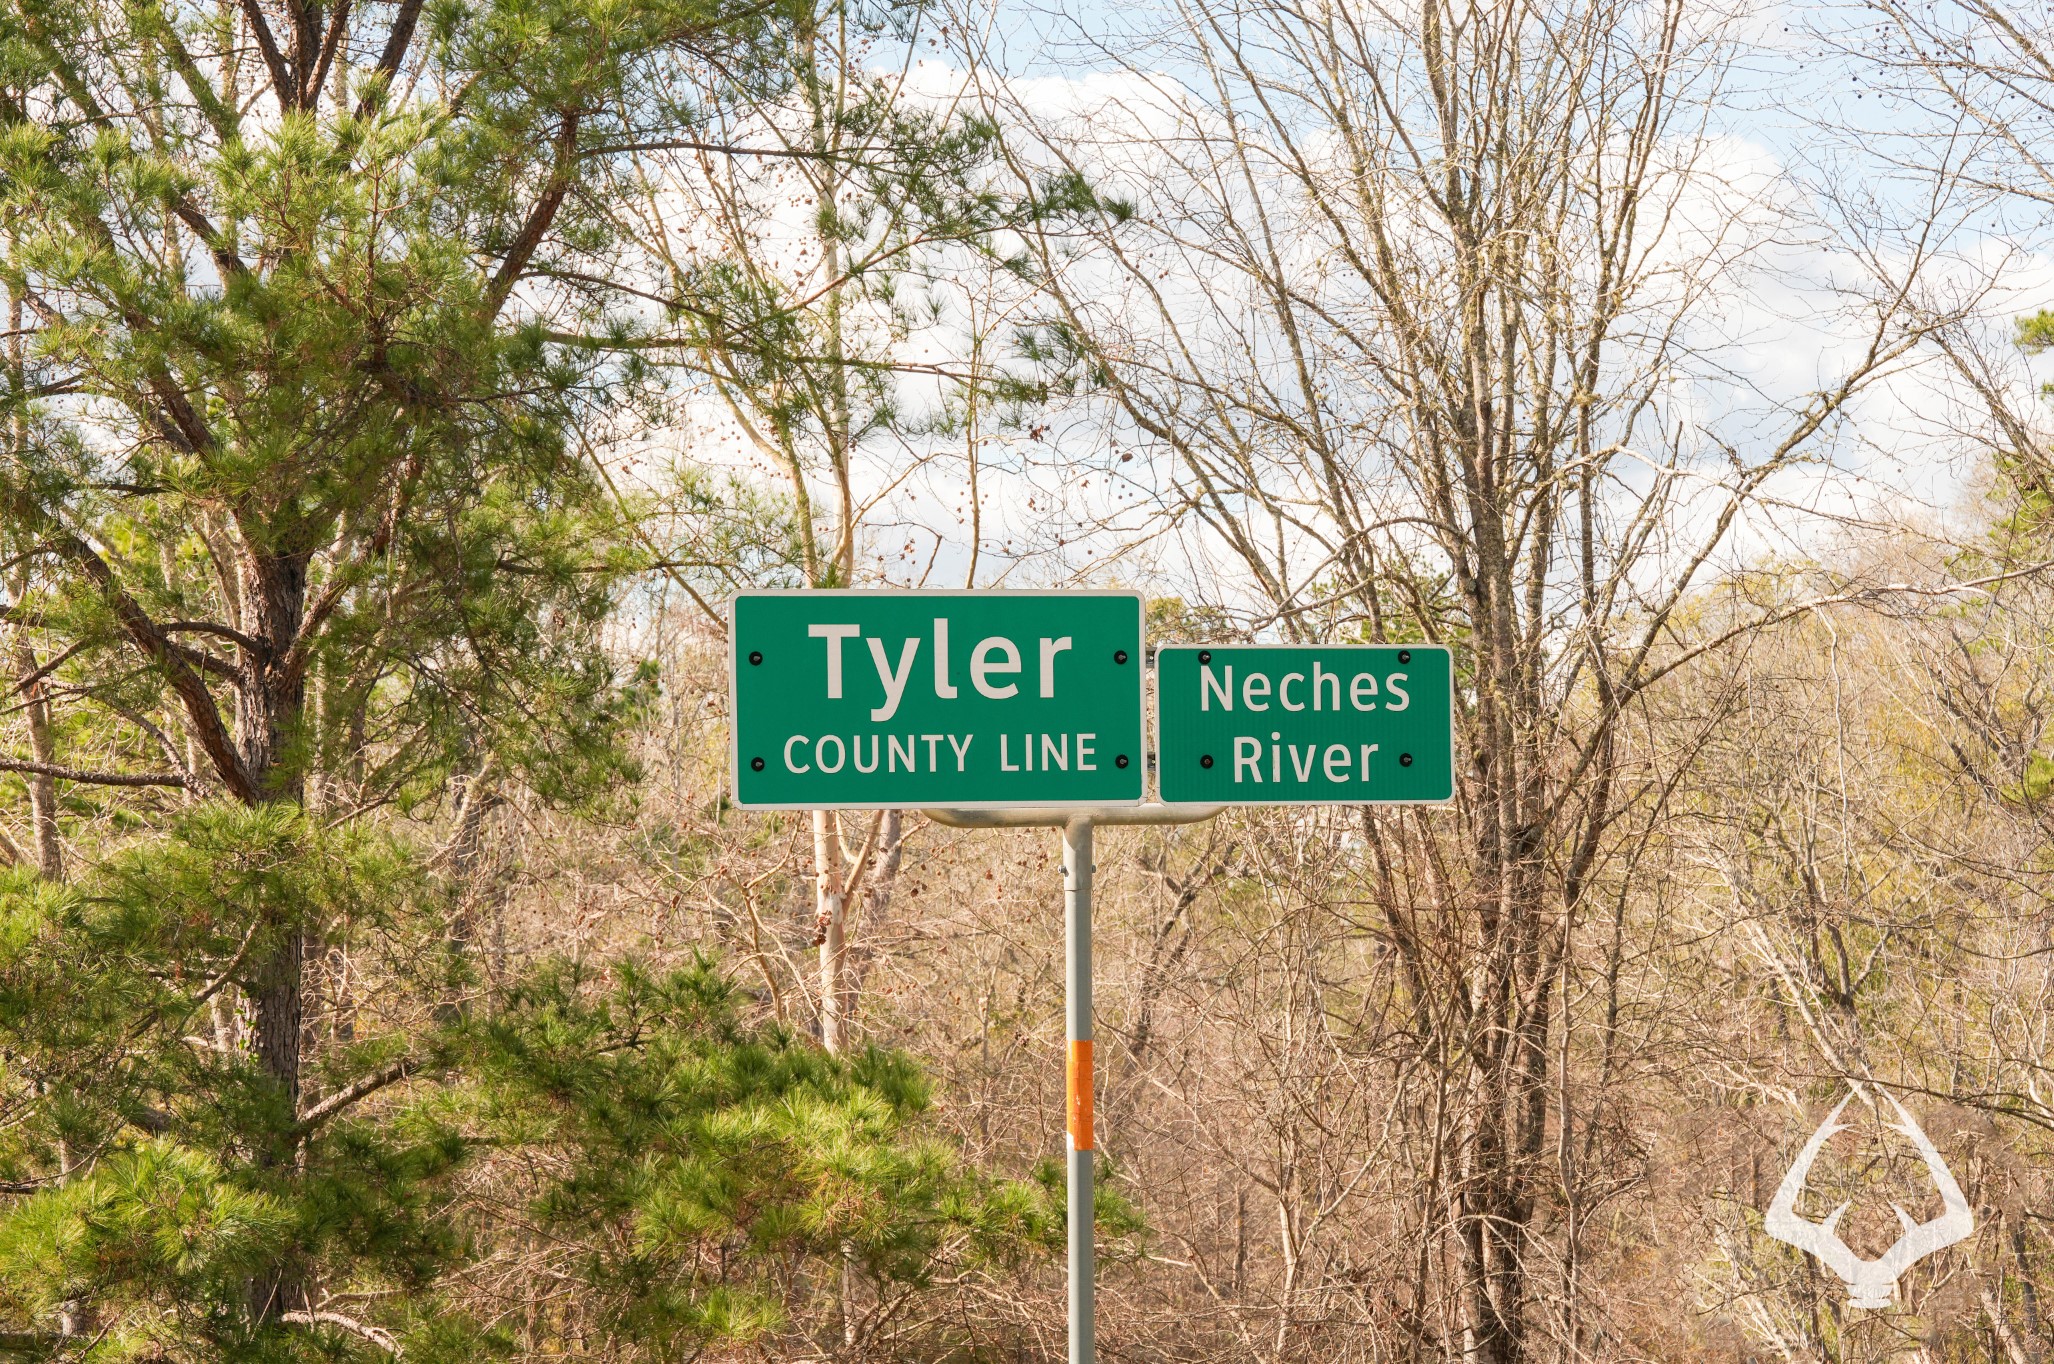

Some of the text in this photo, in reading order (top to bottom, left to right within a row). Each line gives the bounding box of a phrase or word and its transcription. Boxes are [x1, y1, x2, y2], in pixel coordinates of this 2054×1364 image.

[807, 617, 1073, 722] Tyler
[1200, 661, 1411, 712] Neches
[783, 733, 1097, 774] COUNTY LINE
[1233, 731, 1379, 783] River
